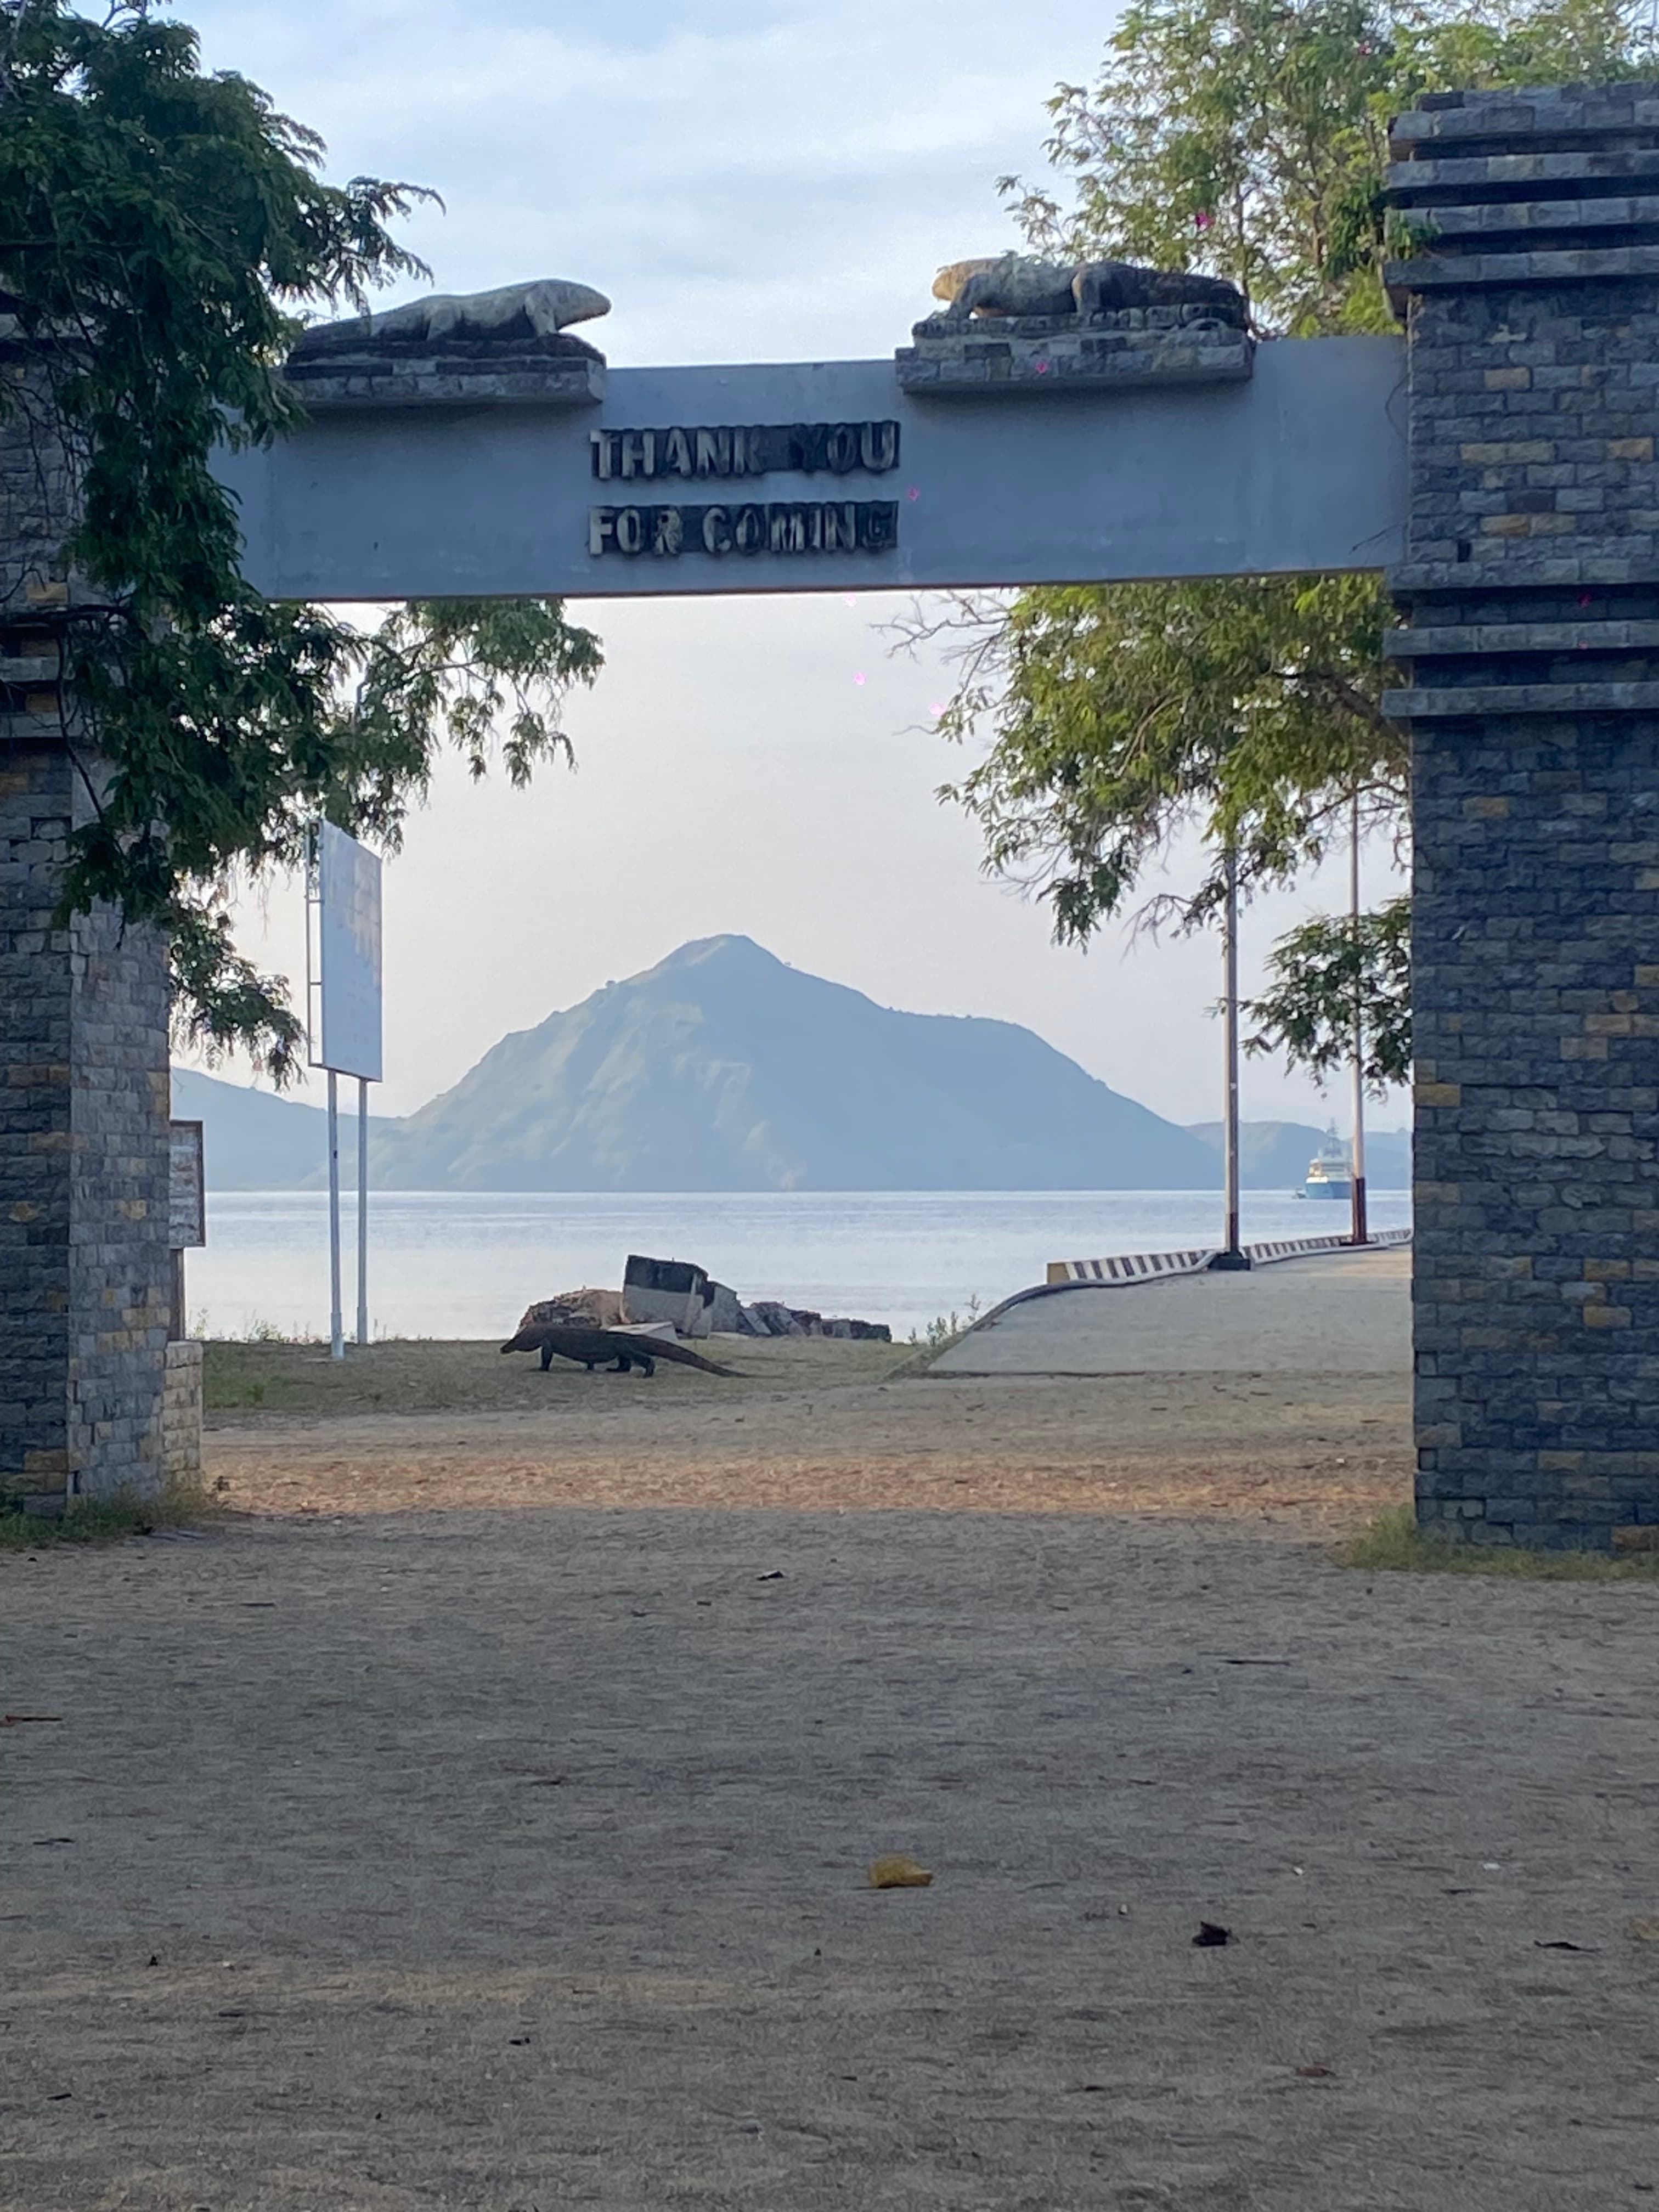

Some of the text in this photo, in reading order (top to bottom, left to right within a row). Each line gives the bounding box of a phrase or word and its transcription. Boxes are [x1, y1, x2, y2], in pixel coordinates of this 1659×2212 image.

[590, 421, 896, 478] THANK YOU
[589, 503, 898, 555] FOR COMING
